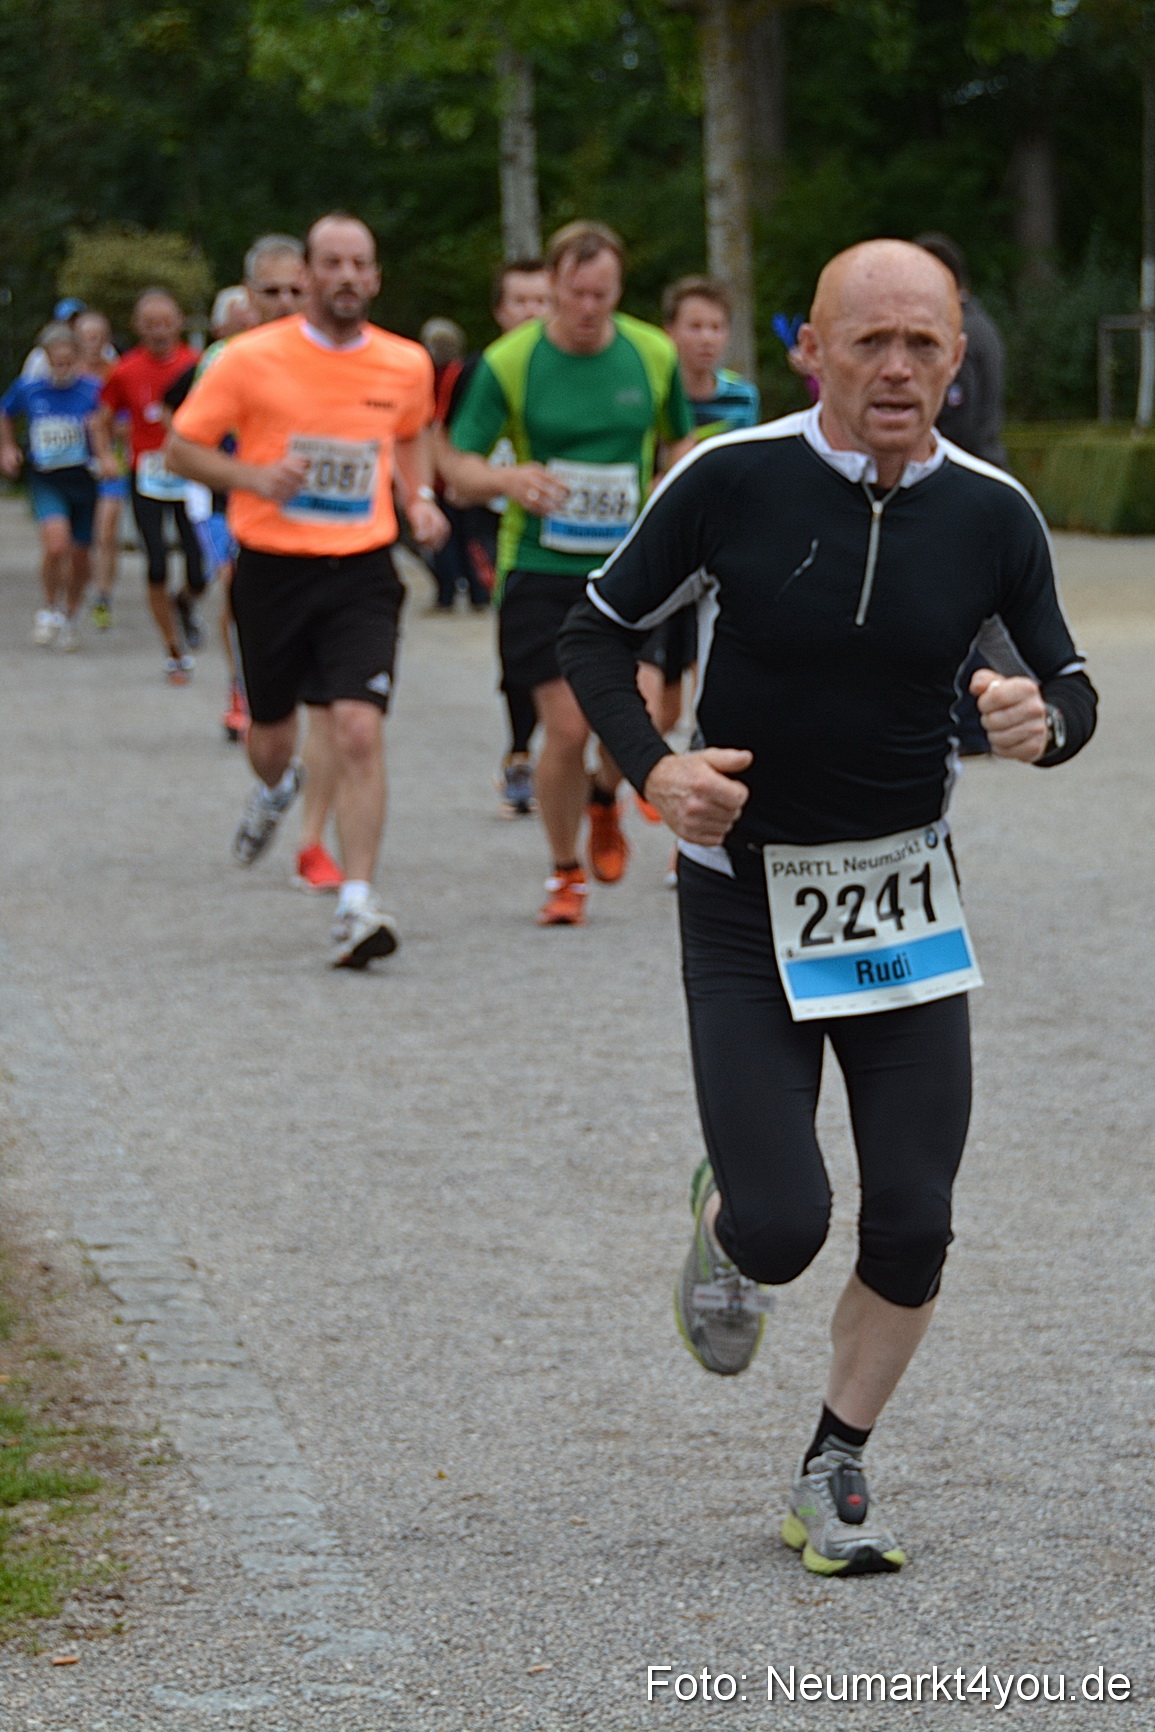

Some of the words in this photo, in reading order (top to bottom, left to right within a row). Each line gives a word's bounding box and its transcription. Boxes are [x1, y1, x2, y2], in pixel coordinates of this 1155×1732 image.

[772, 860, 838, 878] PARTL
[843, 840, 921, 872] Neumarkt
[795, 861, 937, 948] 2241
[855, 952, 913, 985] Rudi
